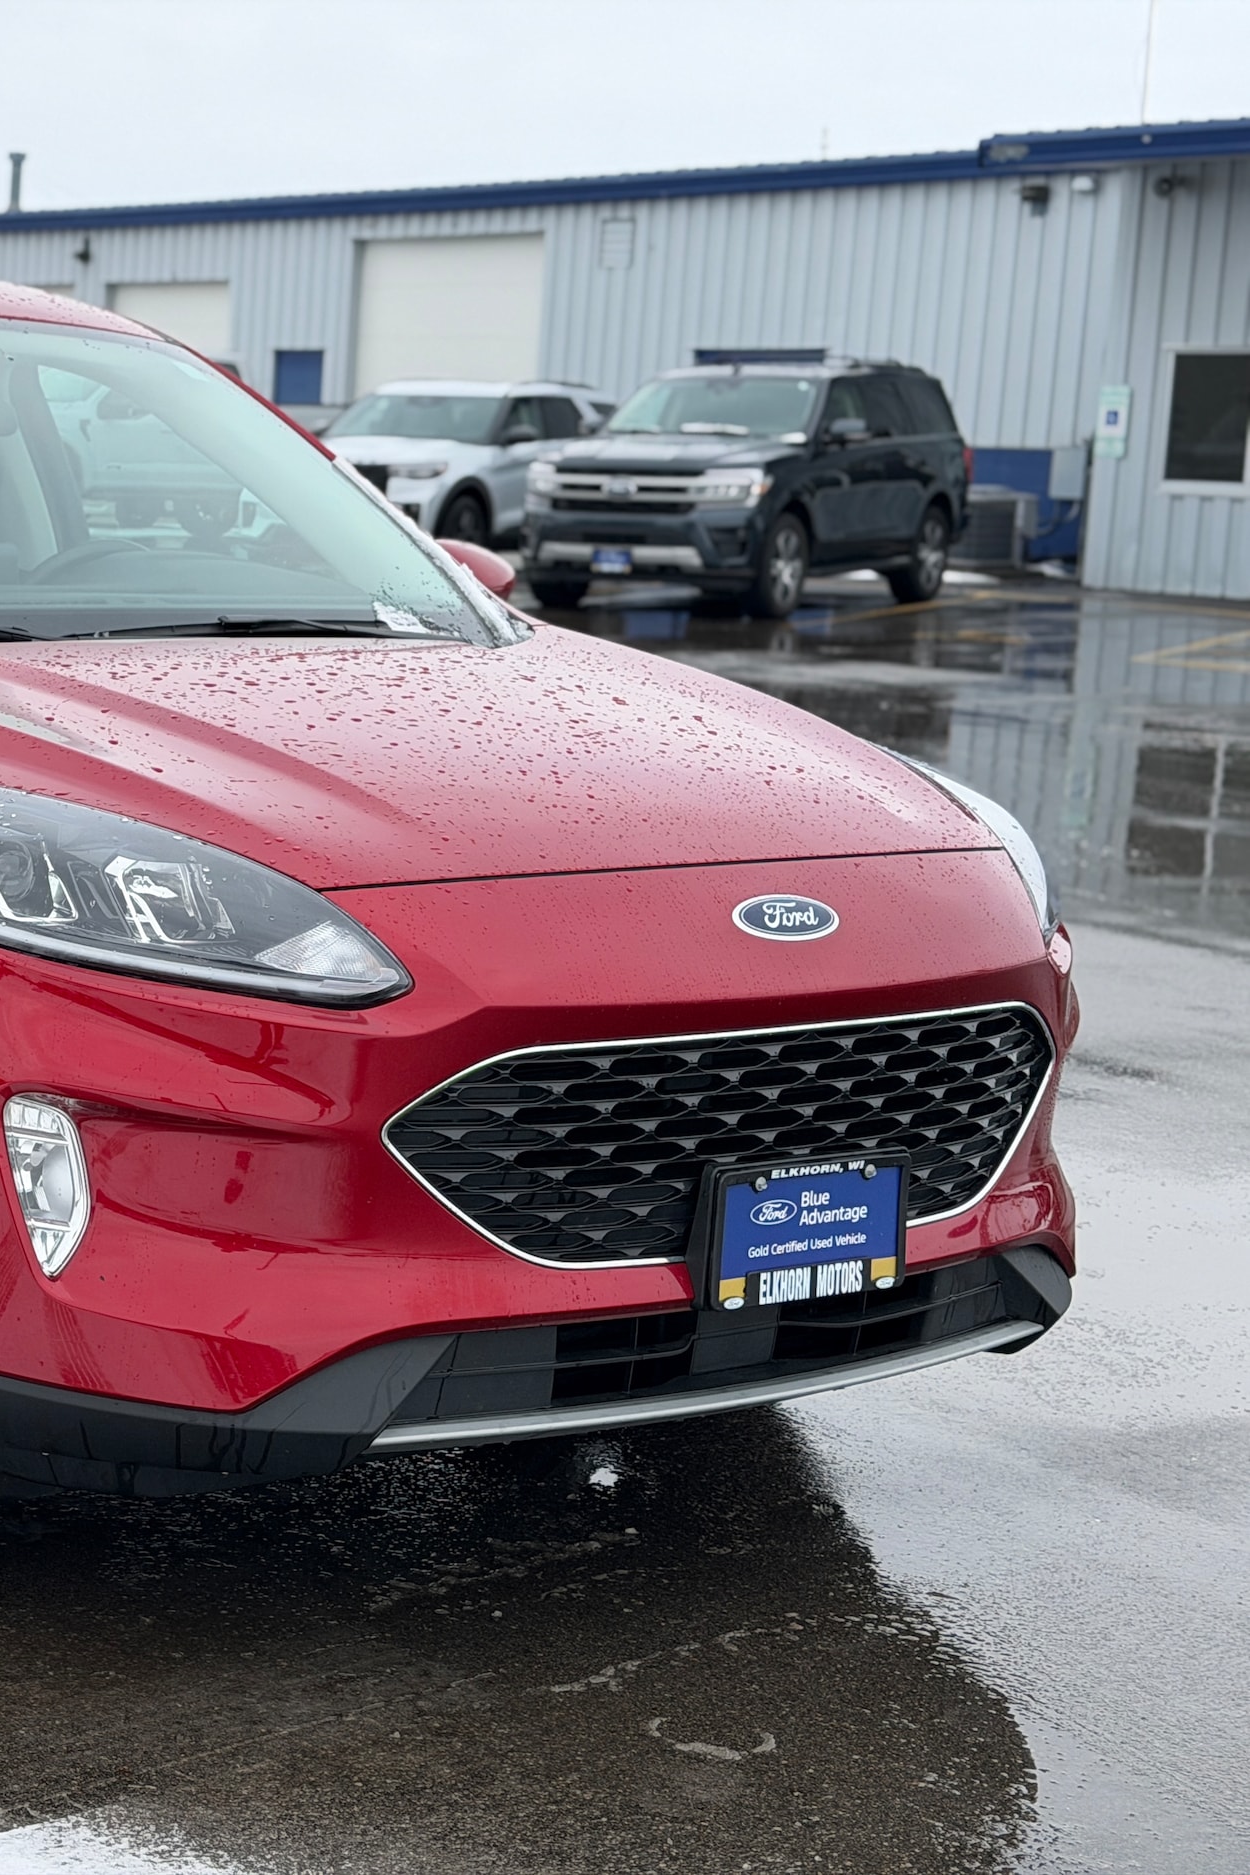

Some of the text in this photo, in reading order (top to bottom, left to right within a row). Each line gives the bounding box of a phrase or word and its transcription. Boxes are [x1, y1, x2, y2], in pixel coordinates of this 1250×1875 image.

[762, 902, 819, 928] Ford
[771, 1160, 865, 1179] ELKHORN, WI
[801, 1190, 830, 1207] Blue
[759, 1203, 789, 1222] Ford
[799, 1205, 868, 1226] Advantage
[748, 1232, 867, 1259] Gold Certified Used Vehicle
[759, 1260, 863, 1305] ELKHORN MOTORS
